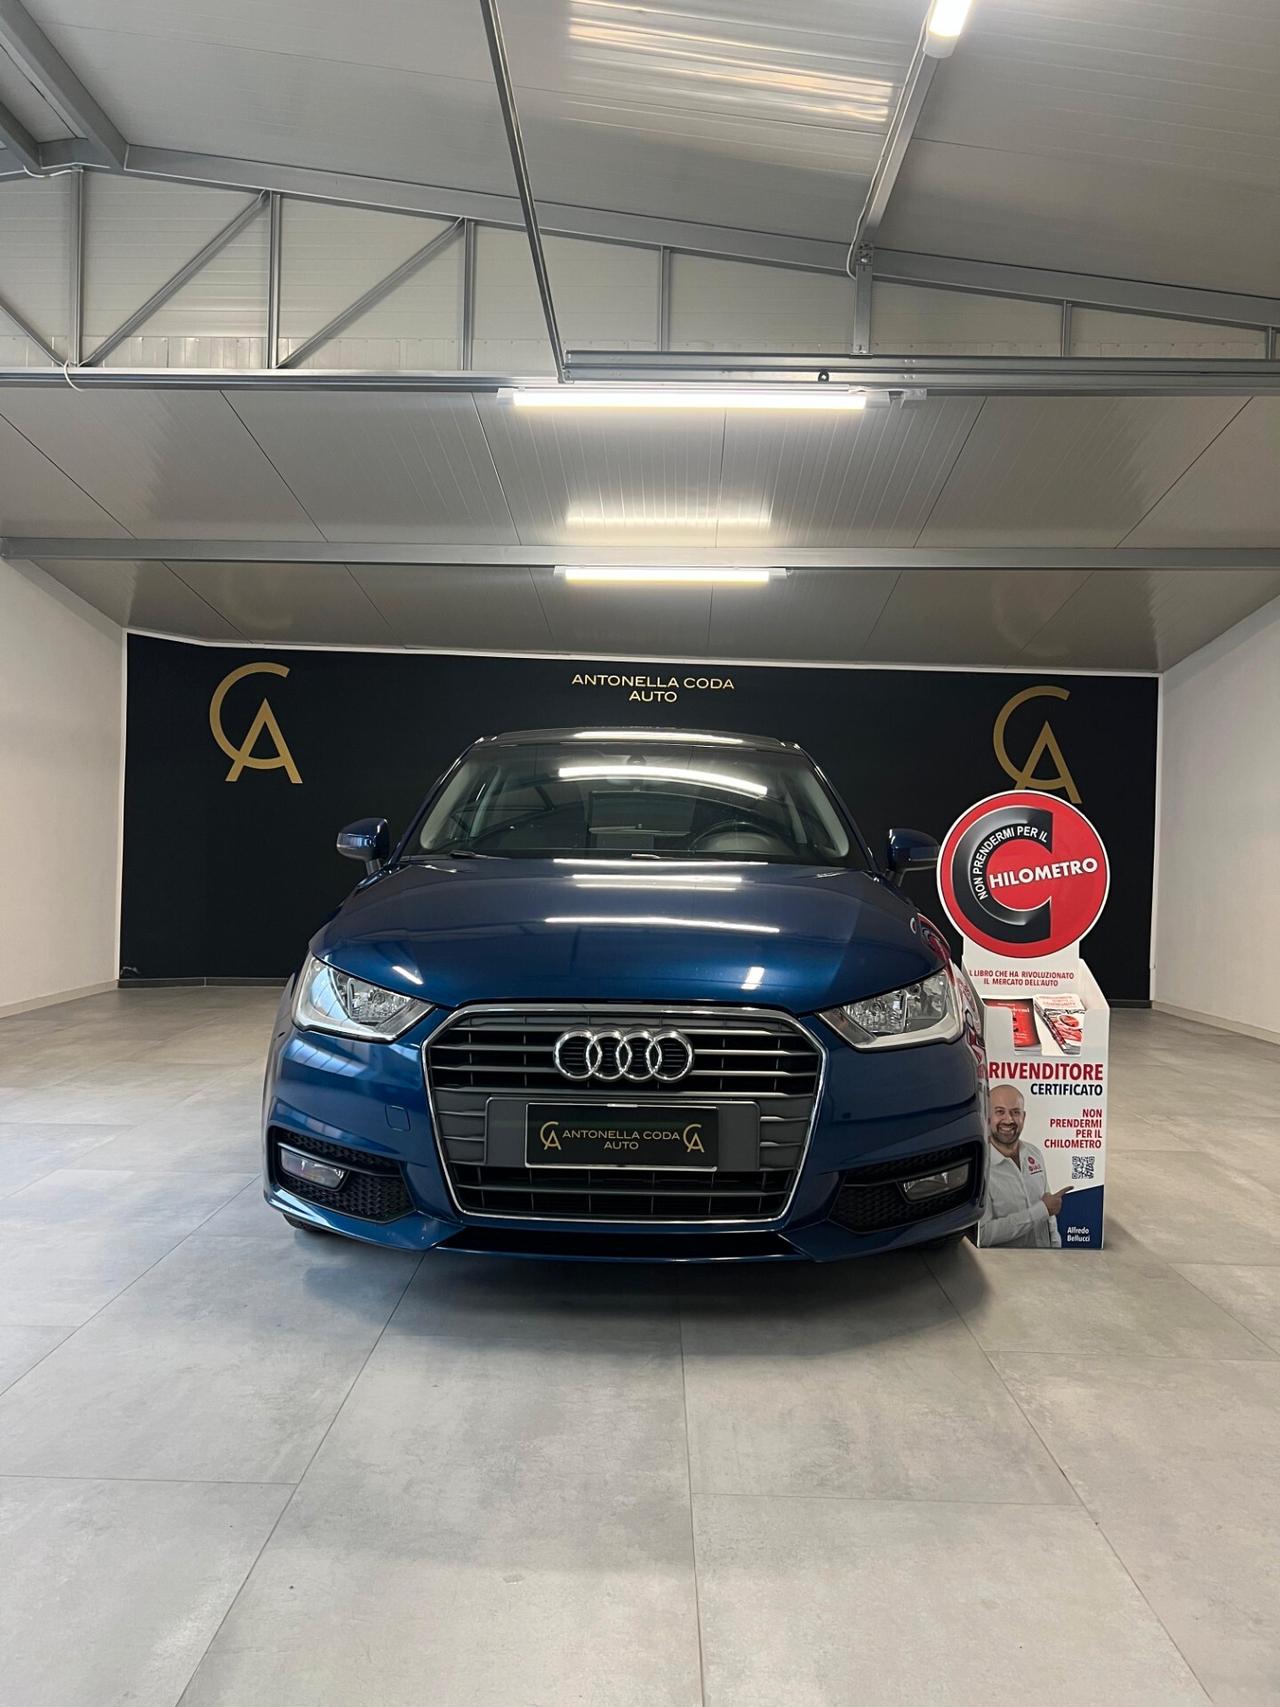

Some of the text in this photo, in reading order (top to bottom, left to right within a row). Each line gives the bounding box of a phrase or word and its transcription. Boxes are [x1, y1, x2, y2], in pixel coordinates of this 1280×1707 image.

[571, 674, 735, 690] ANTONELLA CODA
[629, 691, 678, 703] AUTO
[973, 826, 1048, 900] NON PRENDERMI PER IL
[989, 1062, 1103, 1080] RIVENDITORE
[1031, 1083, 1102, 1096] CERTIFICATO
[1082, 1109, 1102, 1118] NON
[1050, 1119, 1102, 1127] PRENDERMI
[562, 1130, 680, 1140] ANTONELLA CODA
[1076, 1130, 1102, 1138] PER IL
[604, 1142, 639, 1150] AUTO
[1045, 1139, 1101, 1148] CHILOMETRO
